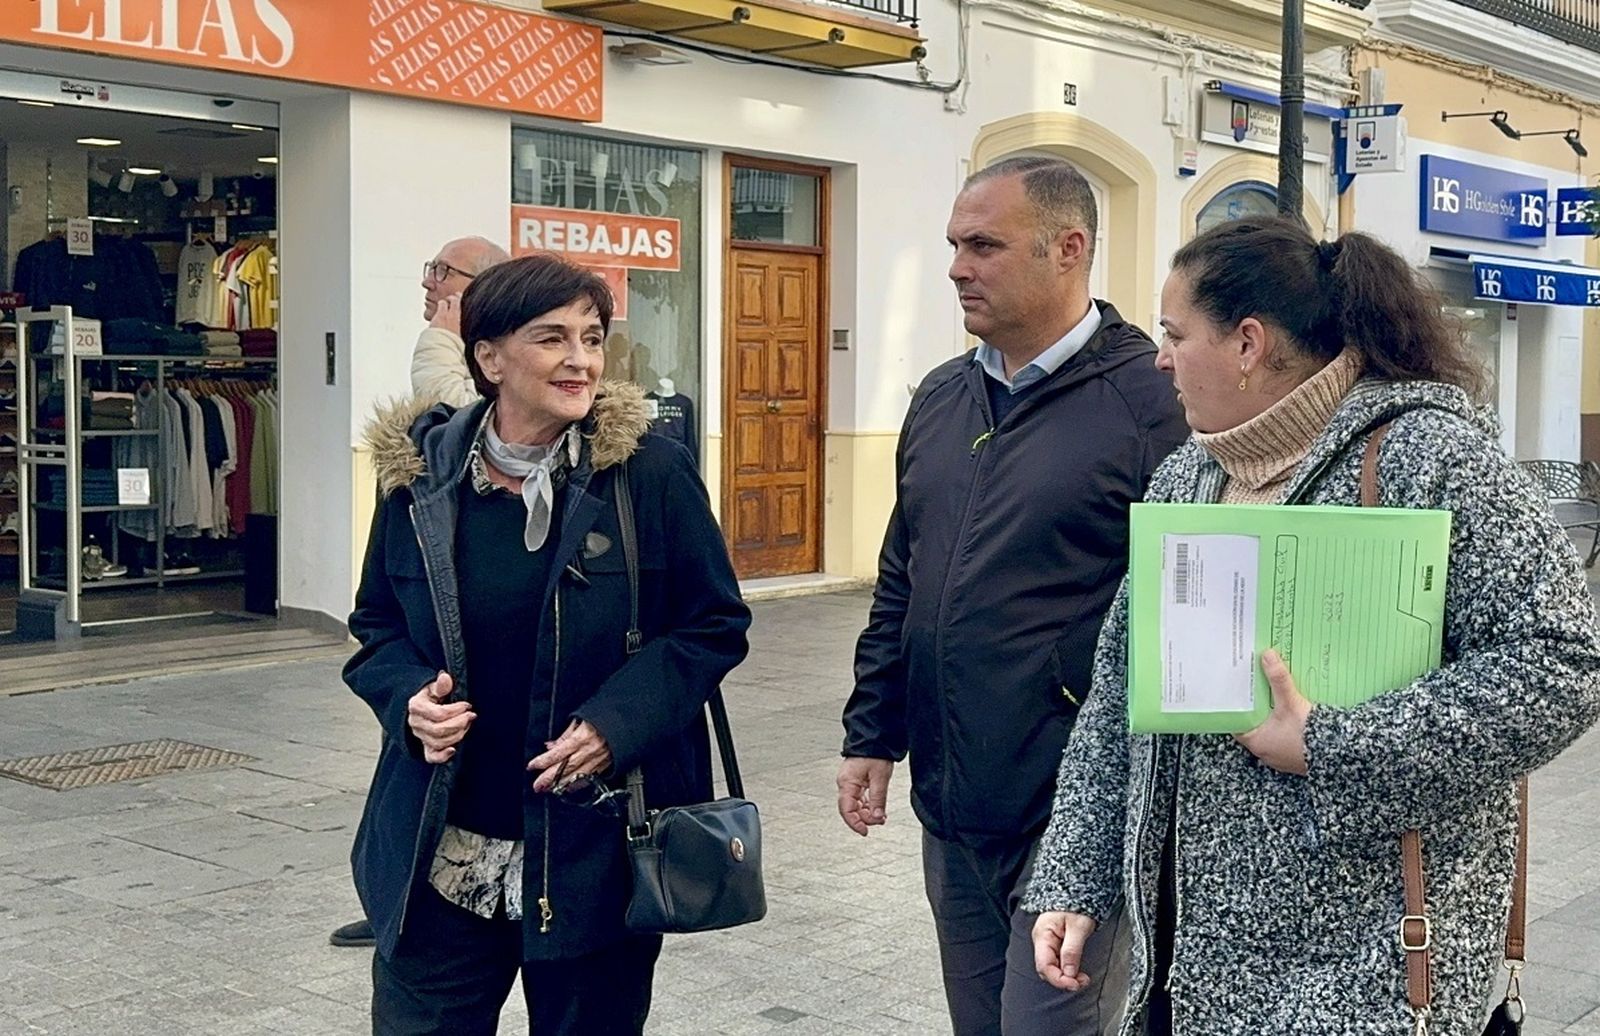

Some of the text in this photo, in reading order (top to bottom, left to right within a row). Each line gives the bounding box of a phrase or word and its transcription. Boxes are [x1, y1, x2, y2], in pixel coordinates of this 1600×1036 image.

[31, 0, 294, 68] ELIAS
[391, 0, 442, 44] ELIAS
[439, 5, 489, 47] ELIAS
[510, 19, 555, 64] ELIAS
[390, 34, 441, 81] ELIAS
[436, 37, 485, 83] ELIAS
[551, 28, 596, 67] ELIAS
[463, 52, 511, 97] ELIAS
[508, 55, 553, 99] ELIAS
[534, 71, 578, 109] ELIAS
[72, 231, 89, 243] 30
[519, 218, 674, 259] REBAJAS
[76, 334, 95, 347] 20
[124, 479, 143, 492] 30
